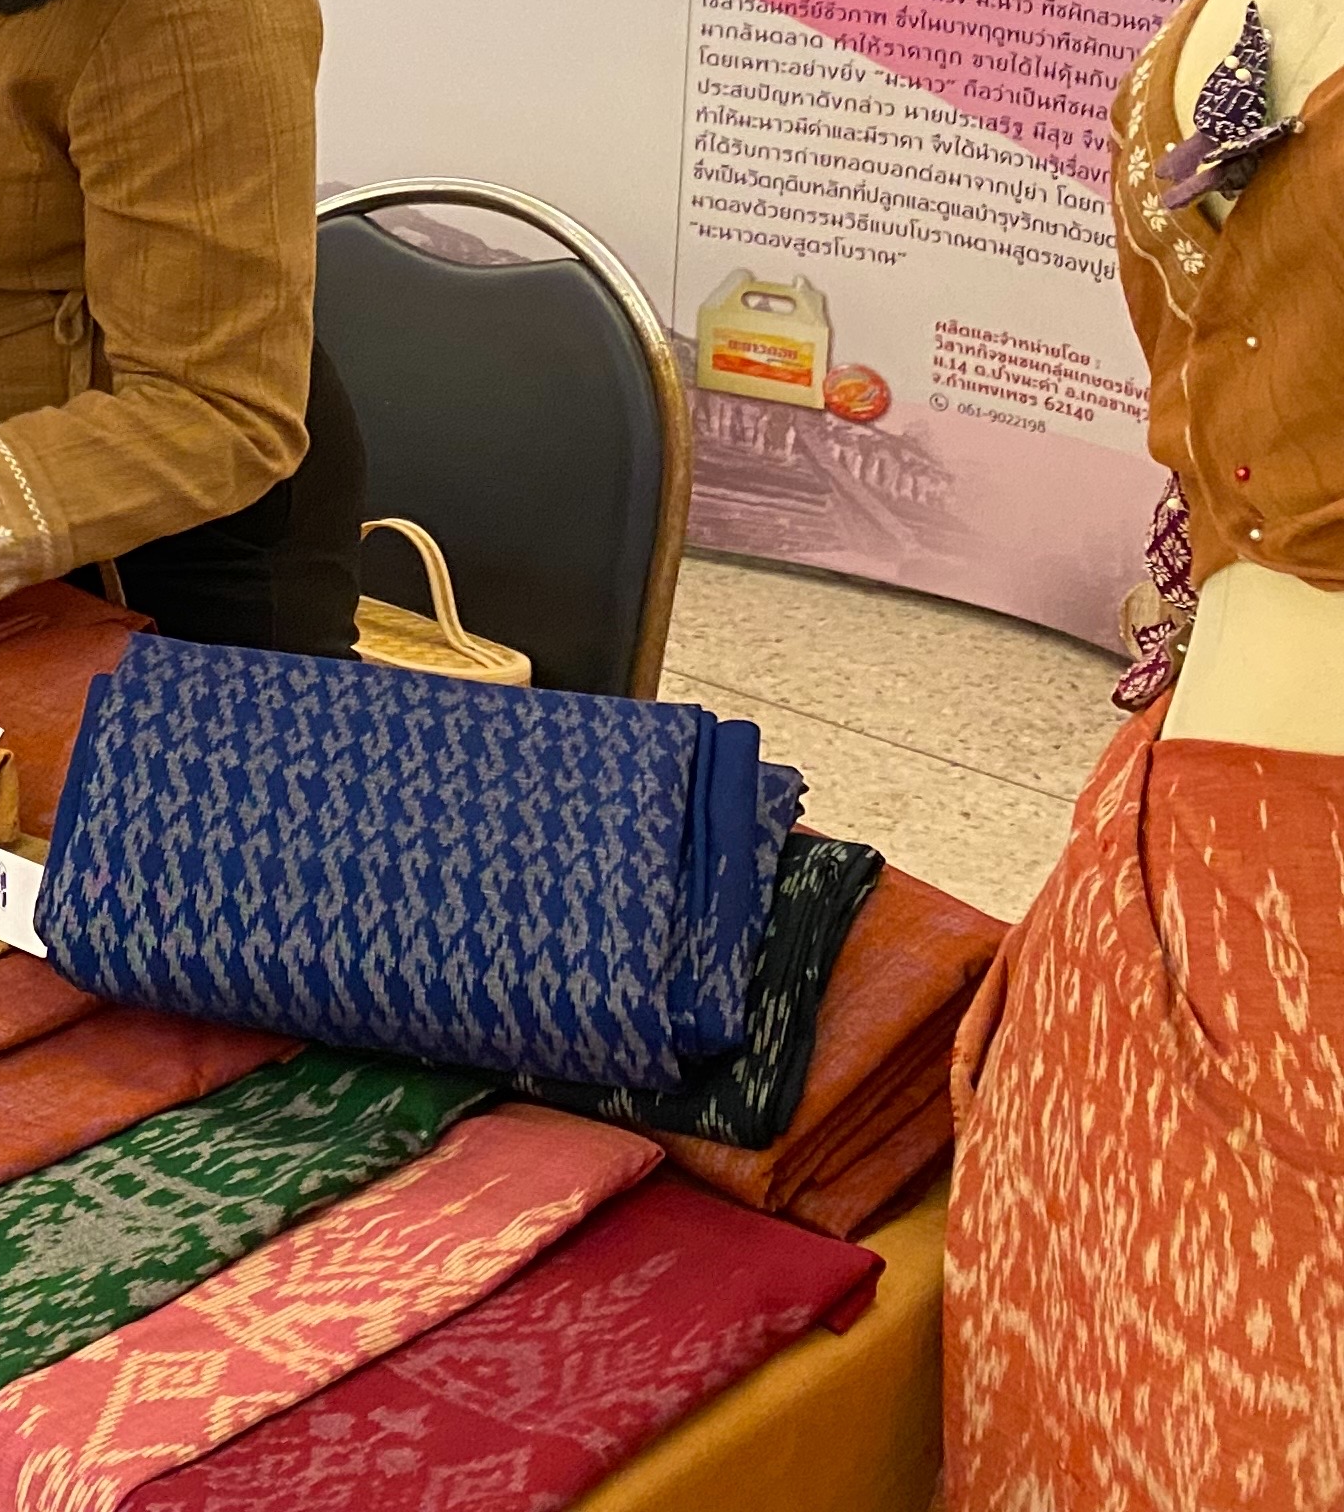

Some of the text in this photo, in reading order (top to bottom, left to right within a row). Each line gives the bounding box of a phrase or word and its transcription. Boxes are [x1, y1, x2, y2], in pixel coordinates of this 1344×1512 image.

[692, 193, 1119, 284] มาดองด้วยกรรมวิธีแบบโบราณตามสูตรของปู่ย่
[1044, 395, 1095, 422] 62140
